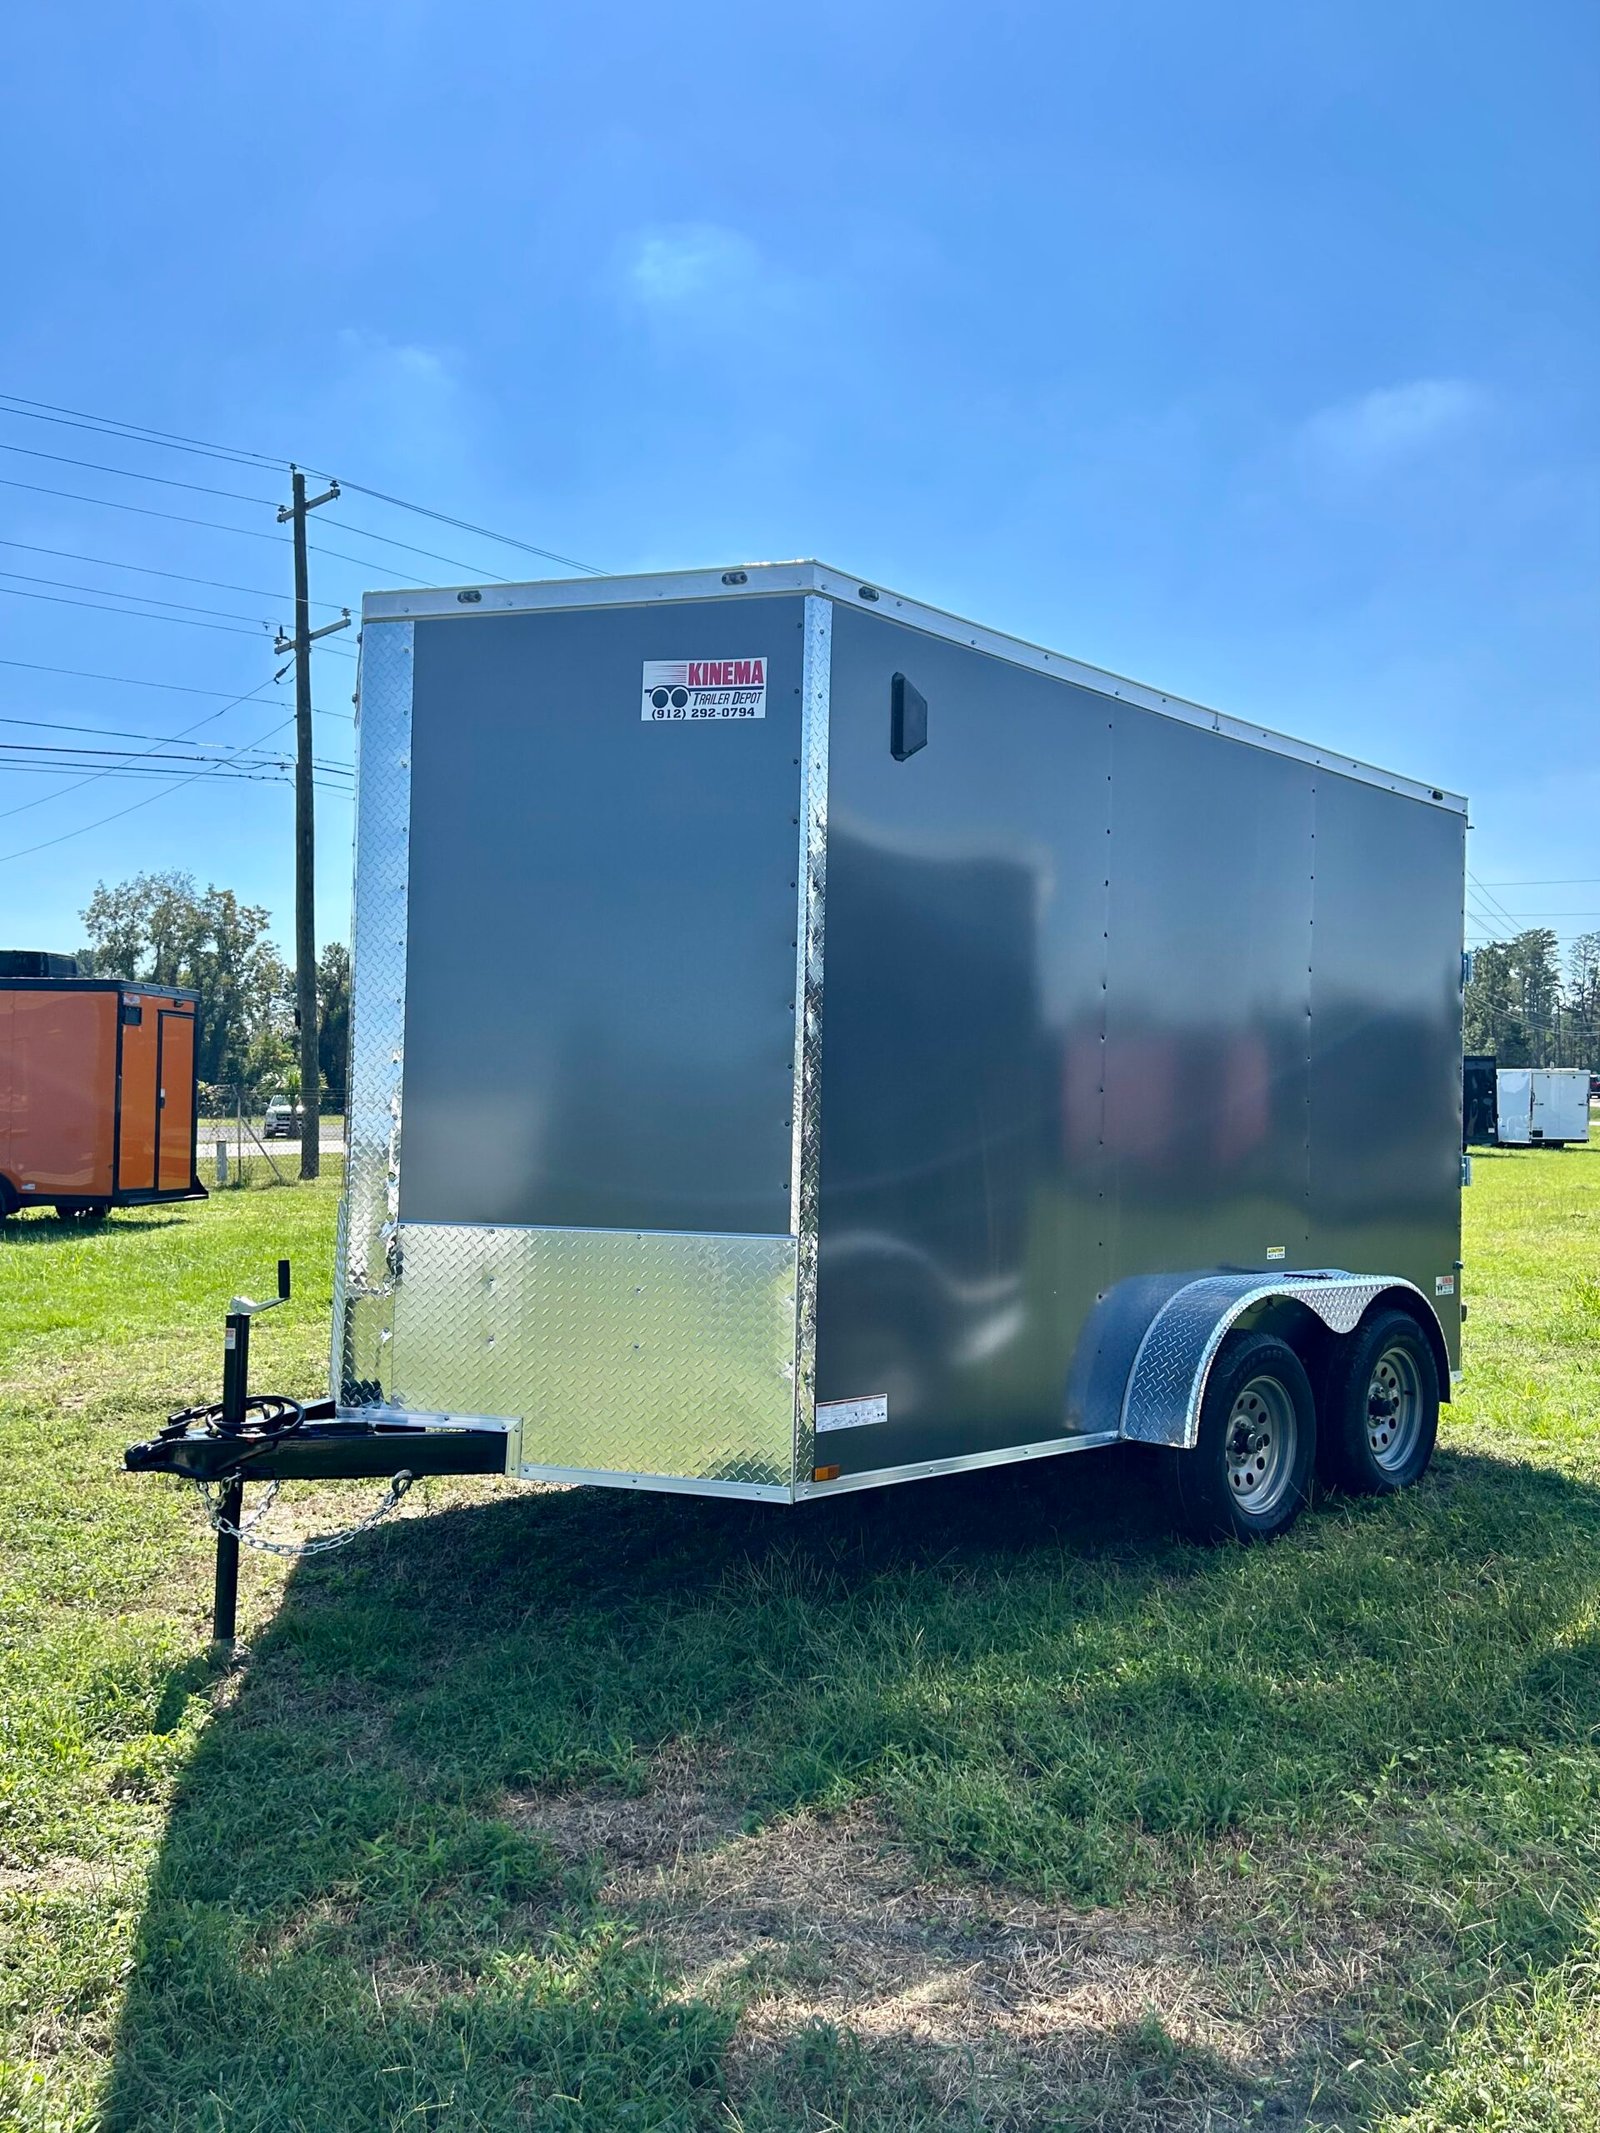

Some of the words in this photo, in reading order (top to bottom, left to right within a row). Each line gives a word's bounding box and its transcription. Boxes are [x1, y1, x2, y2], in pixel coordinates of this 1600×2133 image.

[688, 660, 764, 686] KINEMA
[693, 692, 730, 706] TRAILER
[731, 691, 763, 705] DEPOT
[652, 708, 686, 720] (912)
[691, 707, 755, 718] 292-0794
